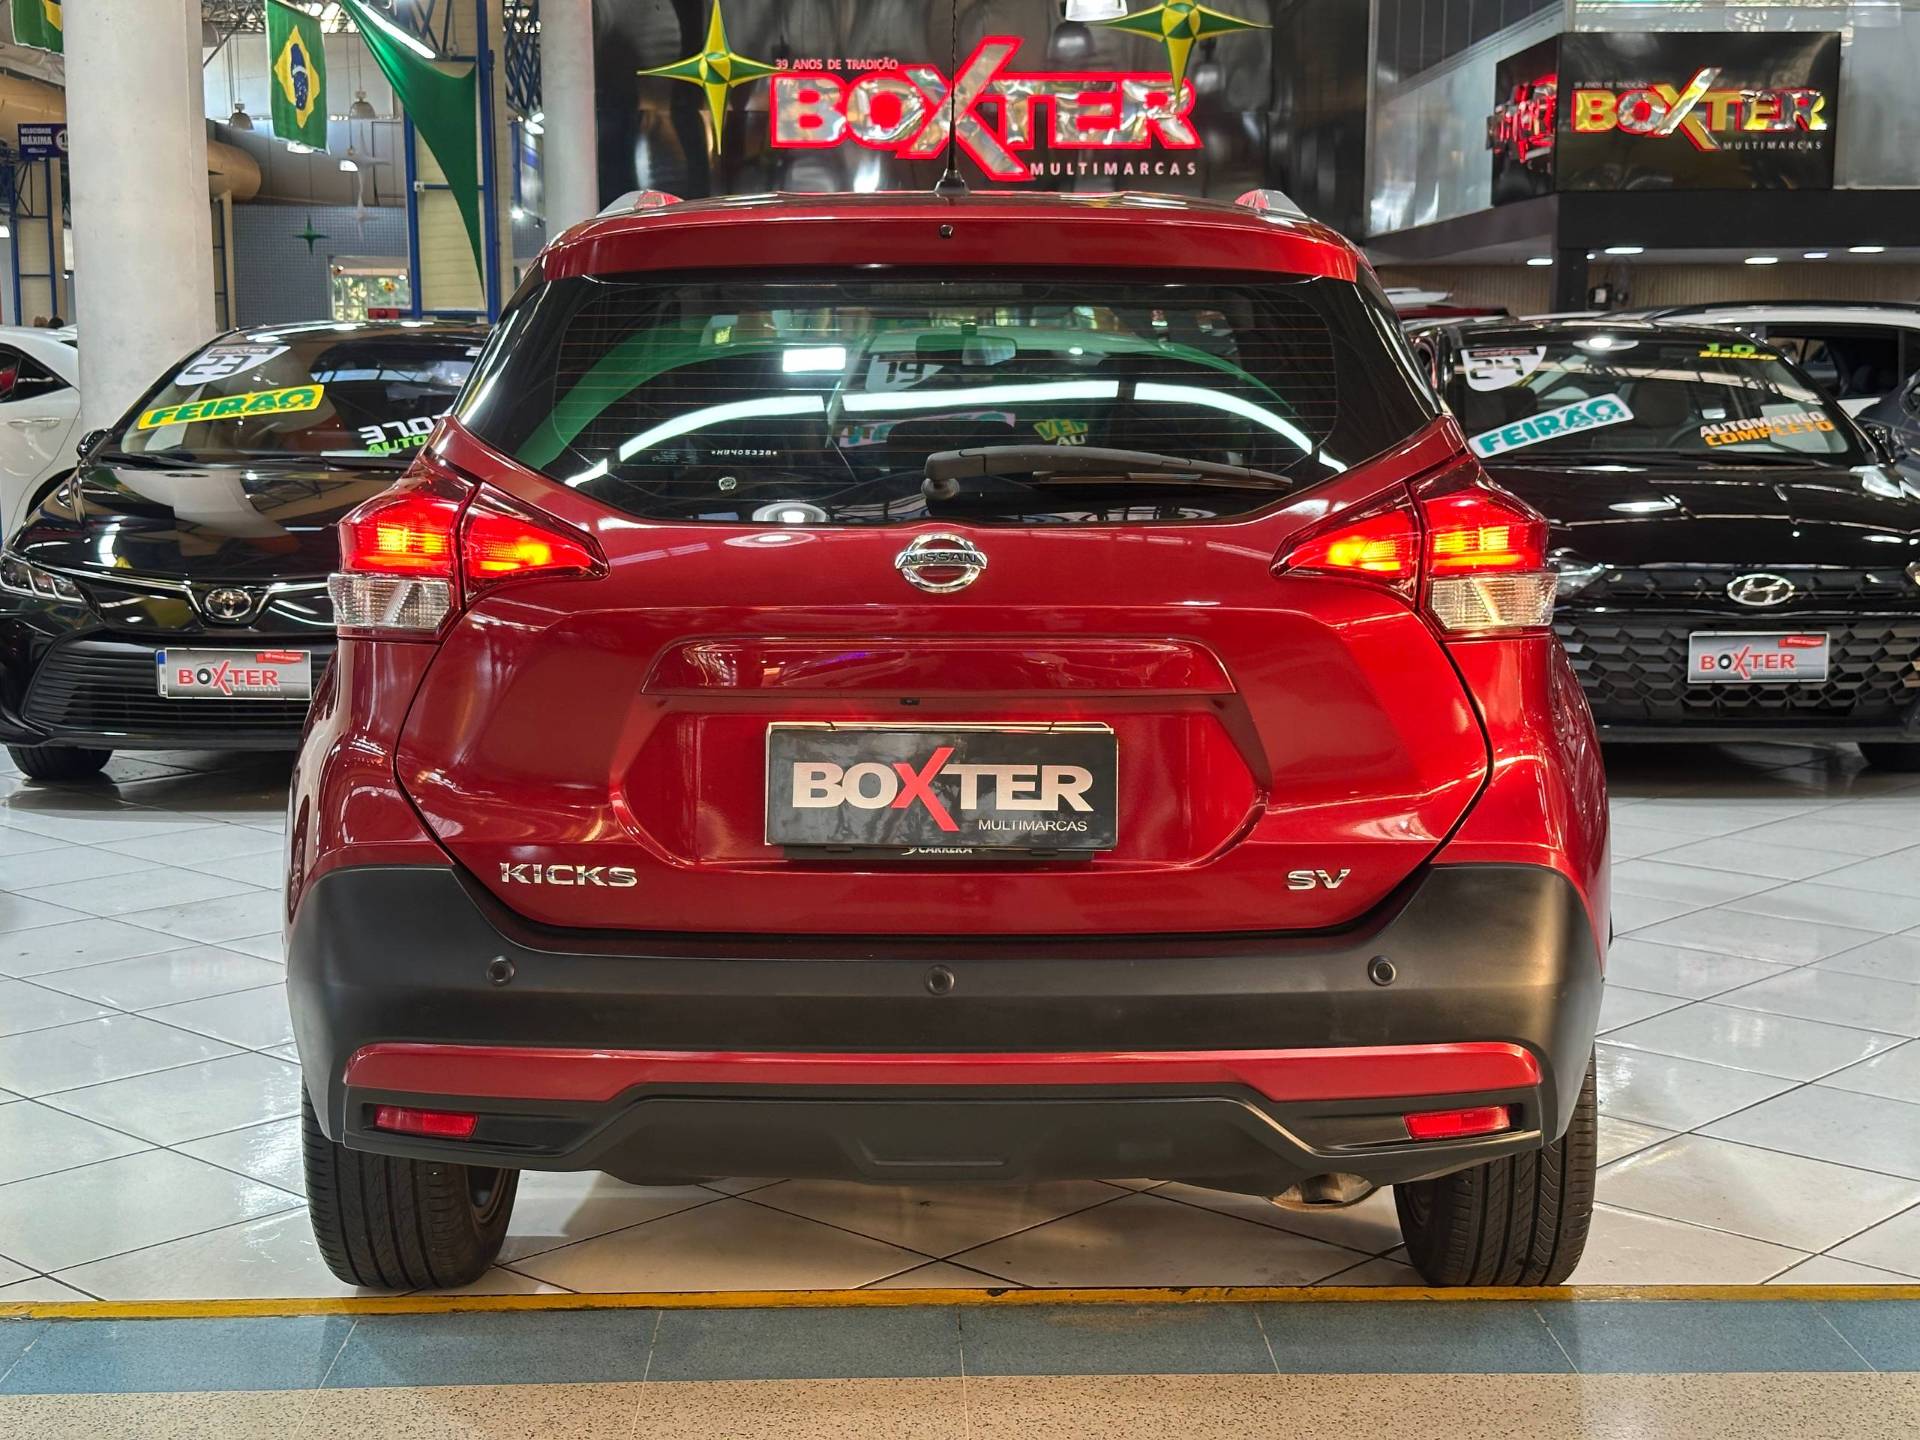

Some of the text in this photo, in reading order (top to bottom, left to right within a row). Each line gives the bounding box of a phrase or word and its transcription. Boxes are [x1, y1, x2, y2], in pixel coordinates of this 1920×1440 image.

[776, 57, 898, 71] 39 ANOS DE TRADIÇÃO
[770, 35, 1204, 181] BOXTER
[1572, 66, 1828, 151] BOXTER
[1723, 141, 1822, 150] MULTIMARCAS
[1030, 162, 1197, 175] MULTIMARCAS
[1705, 421, 1834, 446] COMPLETO
[906, 551, 977, 563] NISSAN
[1700, 644, 1797, 679] BOXTER
[177, 660, 281, 695] BOXTER
[792, 747, 1094, 831] BOXTER
[978, 819, 1088, 832] MULTIMARCAS
[500, 863, 637, 887] KICKS
[1288, 869, 1351, 890] SV
